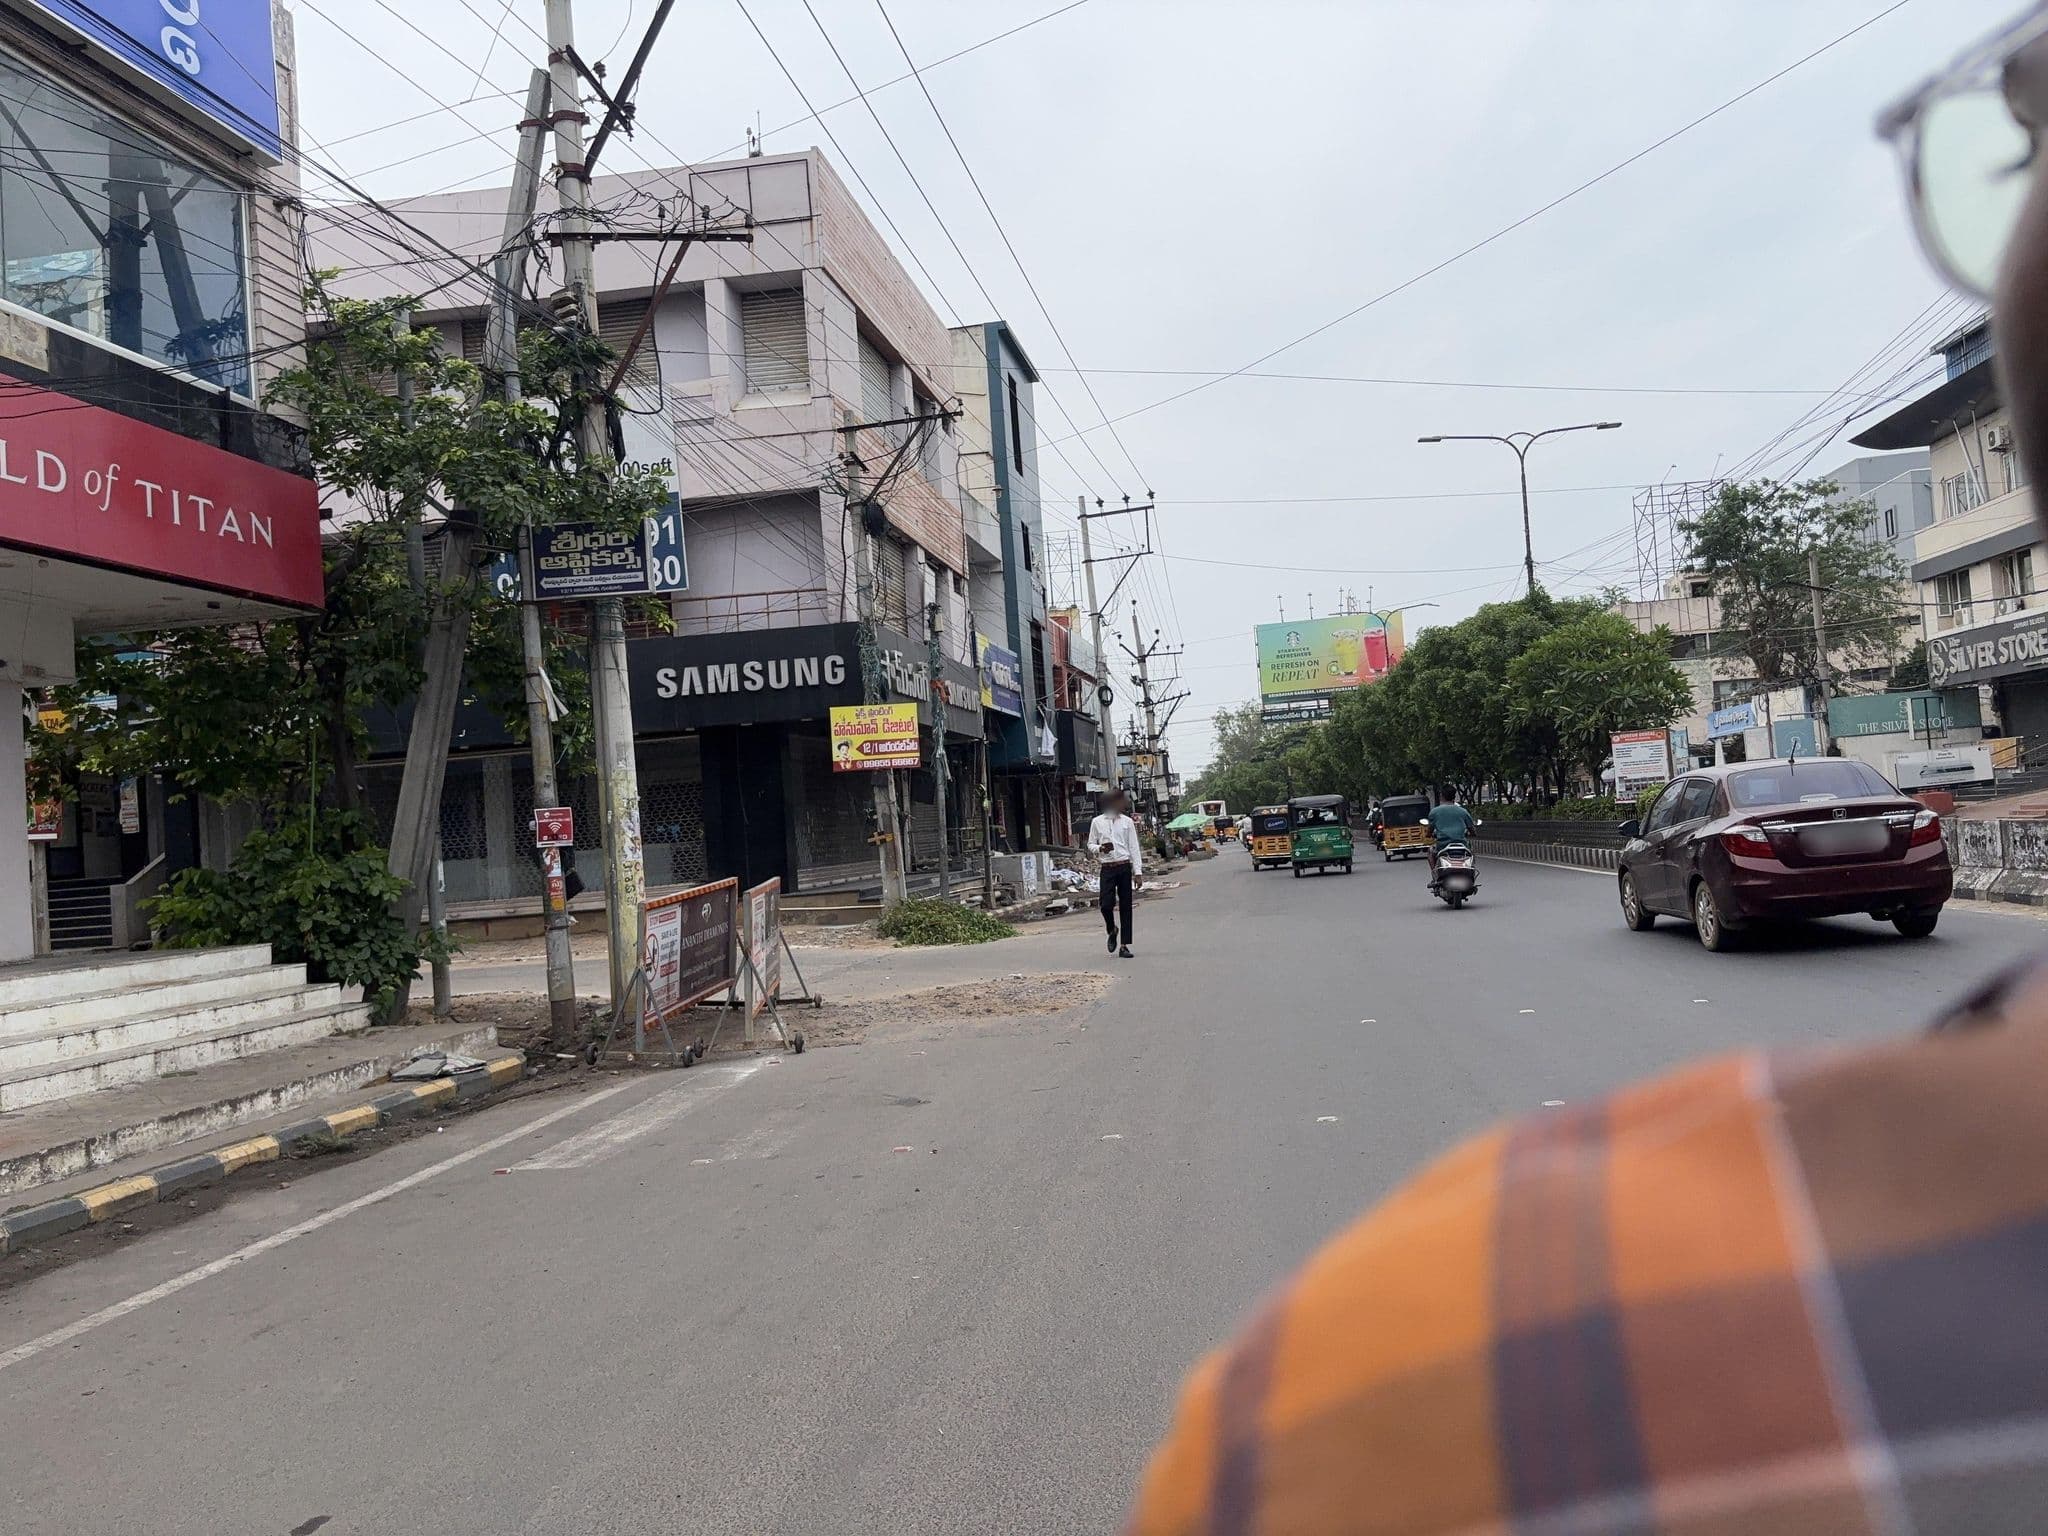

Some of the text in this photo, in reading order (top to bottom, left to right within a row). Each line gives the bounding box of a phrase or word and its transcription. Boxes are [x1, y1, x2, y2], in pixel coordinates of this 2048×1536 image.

[84, 463, 120, 511] of
[134, 479, 273, 549] TITAN
[1998, 628, 2048, 664] STORE
[656, 655, 846, 698] SAMSUNG
[1270, 659, 1320, 670] REFRESH ON
[1272, 669, 1320, 683] REPEAT
[1857, 722, 1878, 734] THE
